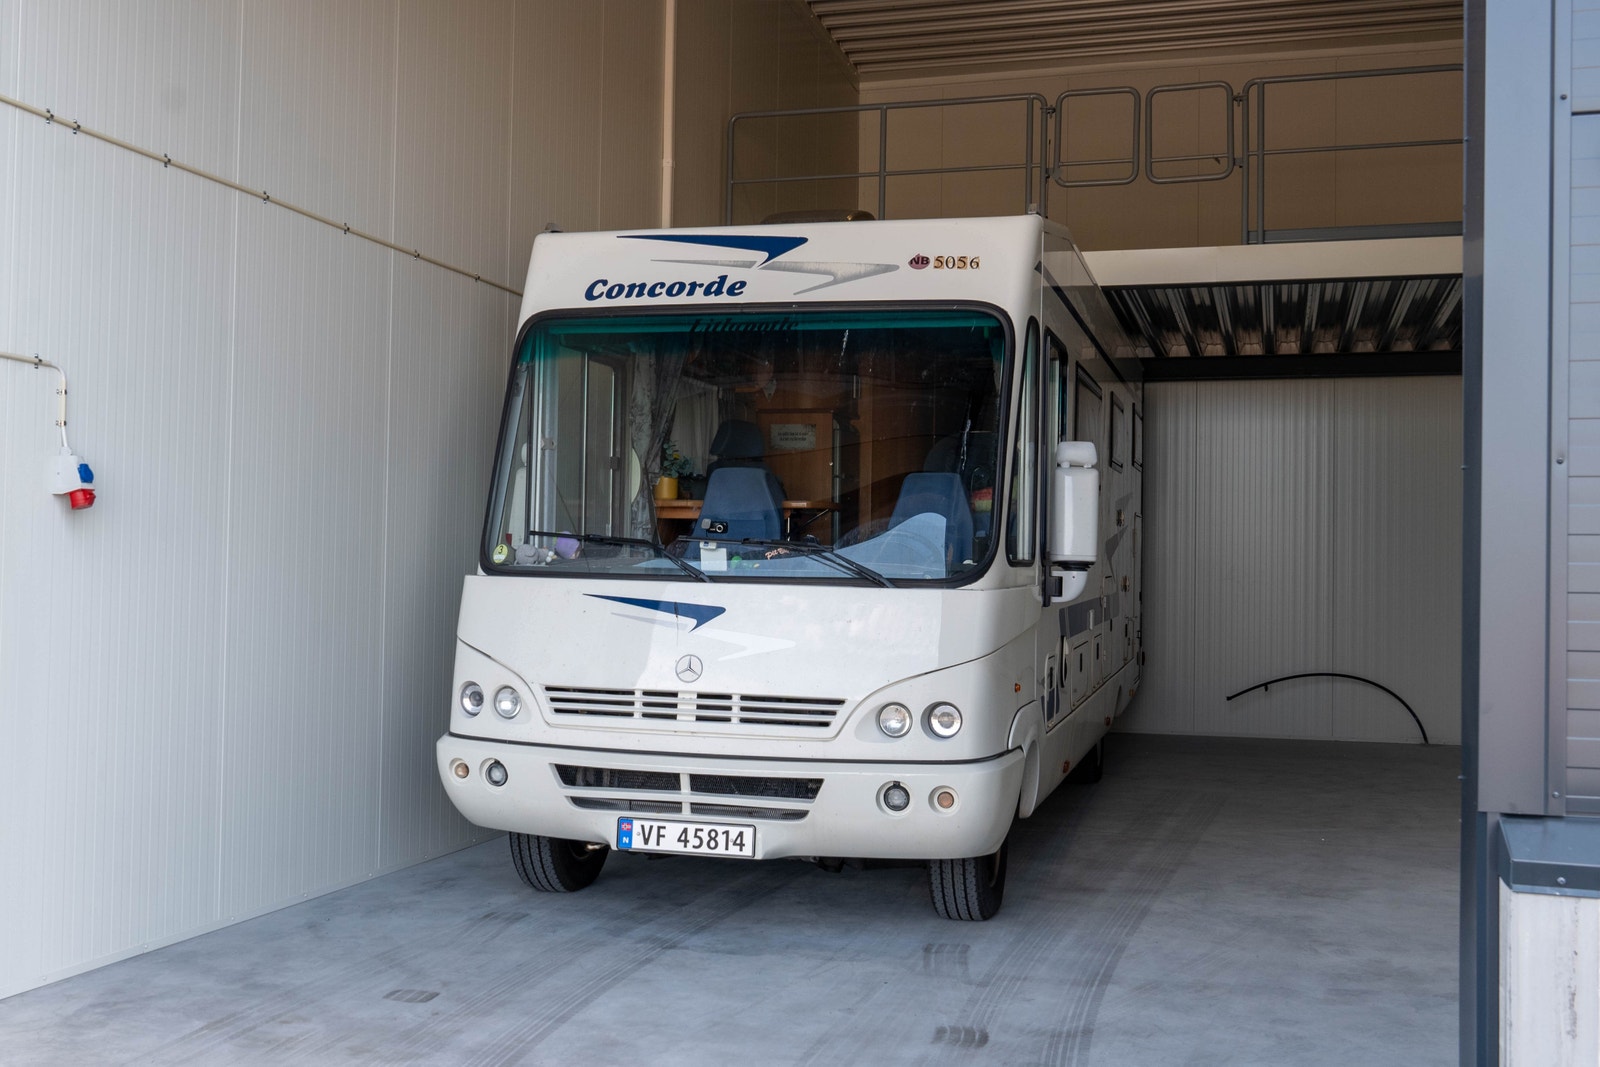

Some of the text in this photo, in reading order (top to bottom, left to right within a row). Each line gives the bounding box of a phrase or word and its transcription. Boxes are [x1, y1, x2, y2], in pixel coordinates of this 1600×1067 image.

[910, 255, 980, 270] NB 5056
[584, 274, 747, 301] Concorde
[622, 836, 629, 844] N
[640, 824, 746, 852] VF 45814
